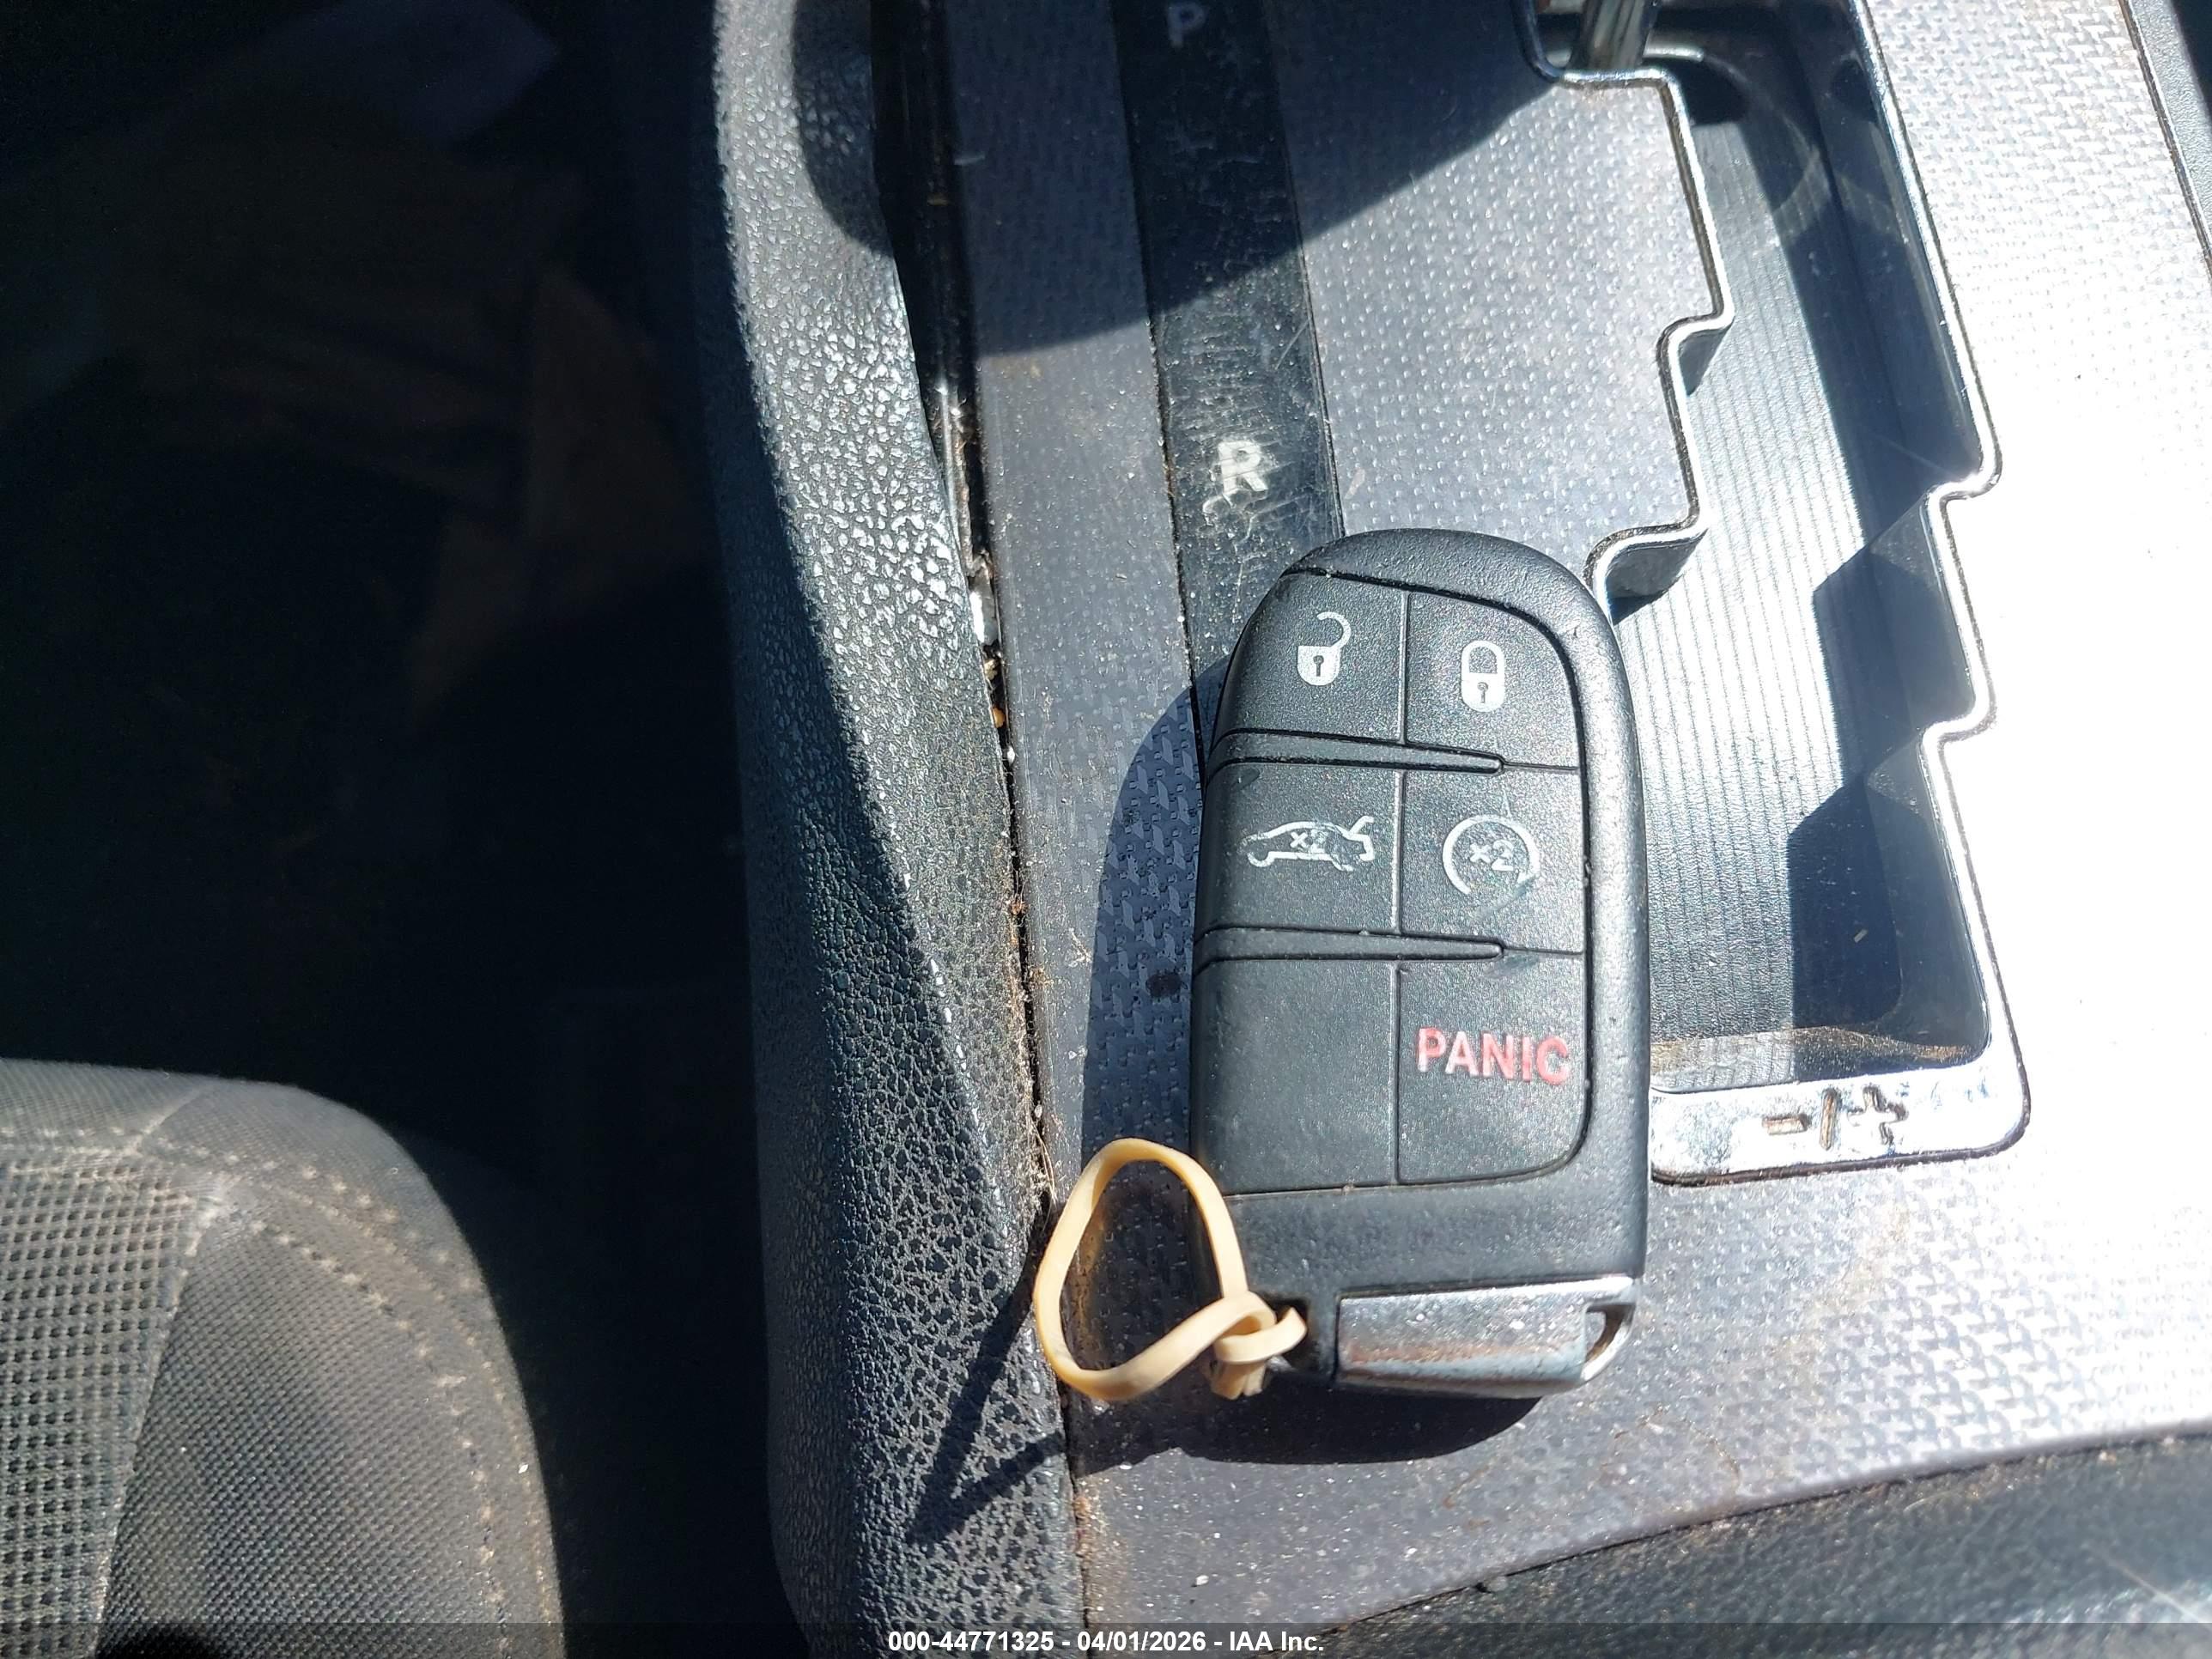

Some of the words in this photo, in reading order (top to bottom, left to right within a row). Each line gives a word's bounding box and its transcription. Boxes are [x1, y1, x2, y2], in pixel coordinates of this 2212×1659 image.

[1167, 2, 1206, 49] P
[1217, 440, 1268, 495] R
[1417, 1026, 1570, 1085] PANIC
